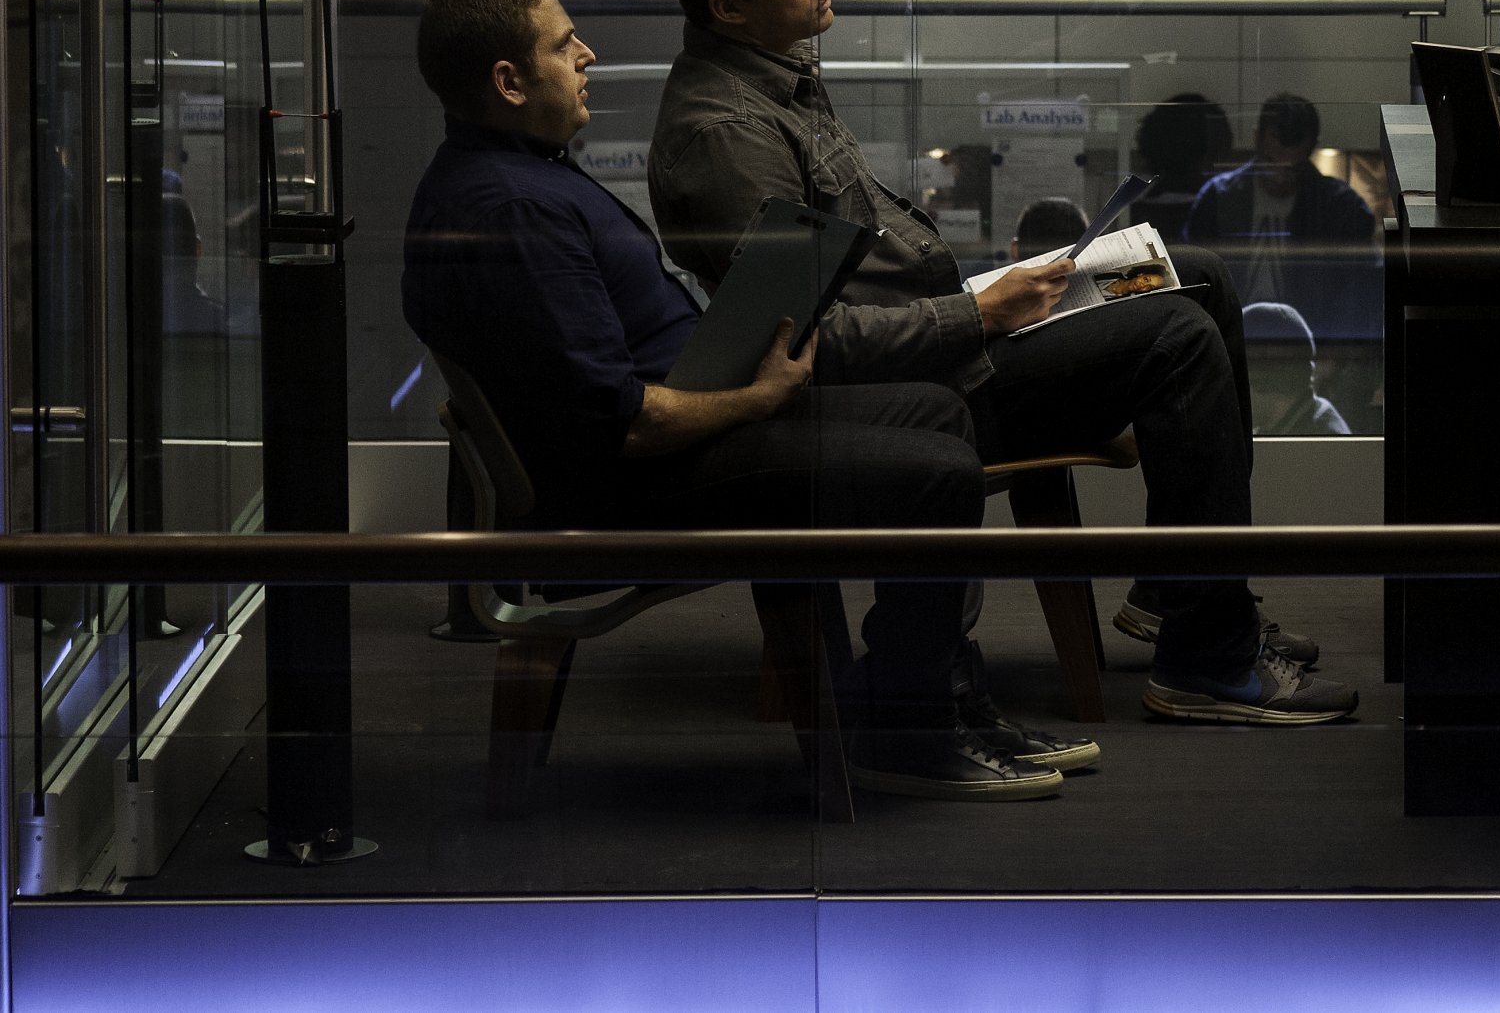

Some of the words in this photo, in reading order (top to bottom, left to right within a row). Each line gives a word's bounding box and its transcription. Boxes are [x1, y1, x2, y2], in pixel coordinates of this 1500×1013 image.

[986, 108, 1014, 124] Lab
[1019, 108, 1084, 130] Analysis
[583, 153, 633, 169] Aerial
